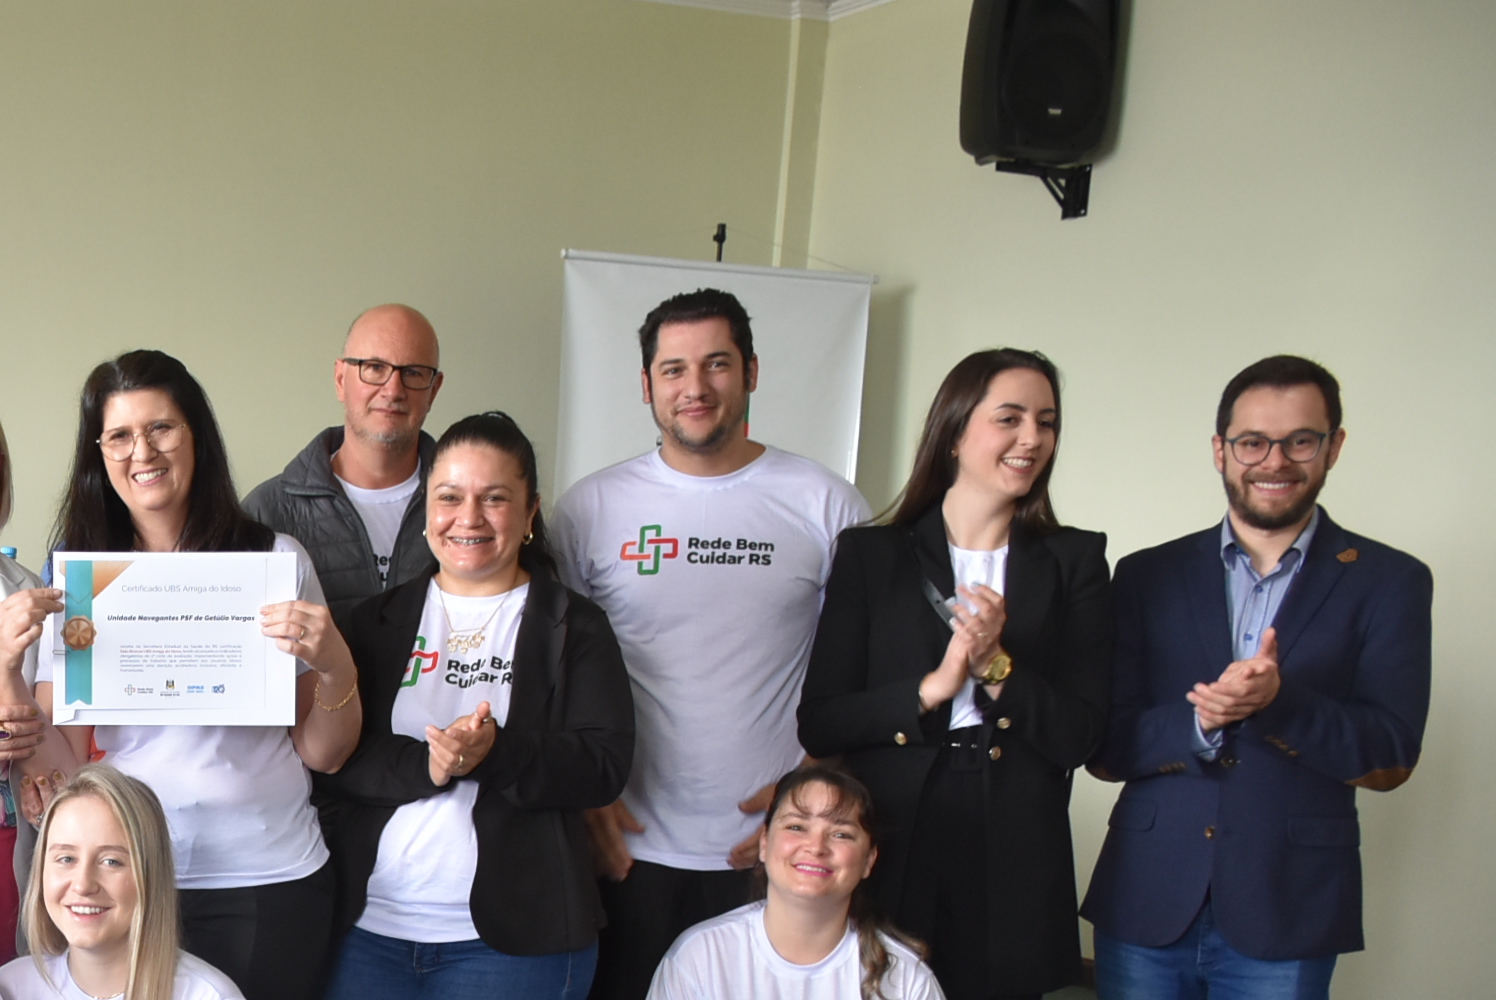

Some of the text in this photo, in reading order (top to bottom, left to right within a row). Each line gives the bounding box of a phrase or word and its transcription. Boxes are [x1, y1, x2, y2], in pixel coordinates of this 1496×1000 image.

[688, 537, 775, 552] Rede Bem
[687, 551, 772, 566] Cuidar RS
[121, 585, 163, 593] Certificado
[182, 585, 207, 594] Amiga
[107, 614, 137, 622] Unidade
[138, 614, 179, 623] Navegantes
[231, 614, 255, 623] Vargas
[447, 655, 514, 674] Red Be
[501, 672, 513, 685] R
